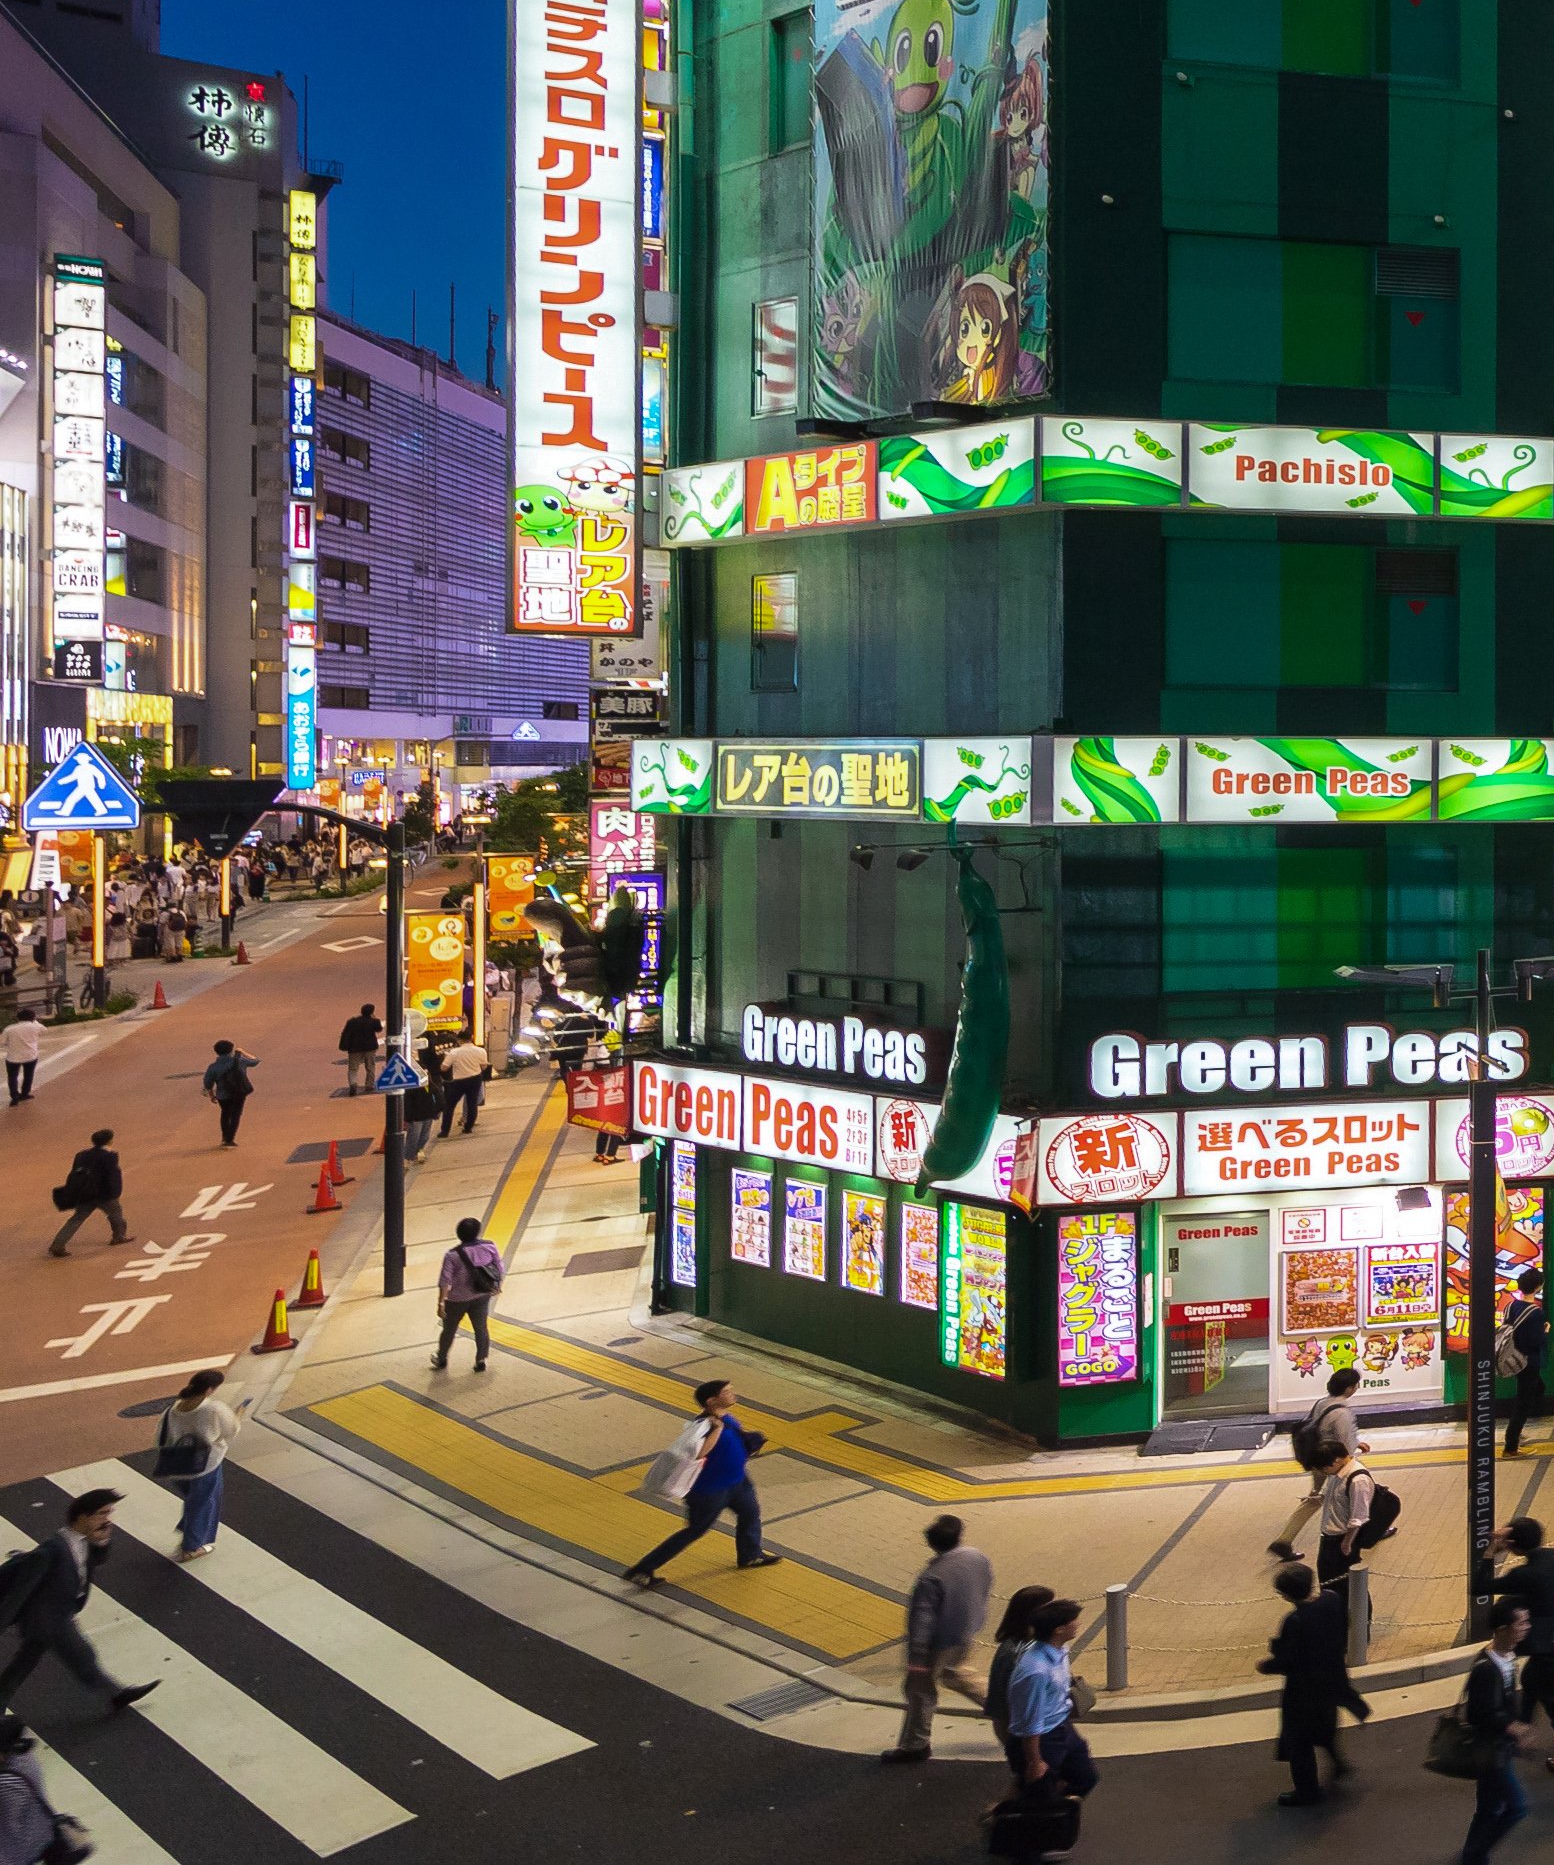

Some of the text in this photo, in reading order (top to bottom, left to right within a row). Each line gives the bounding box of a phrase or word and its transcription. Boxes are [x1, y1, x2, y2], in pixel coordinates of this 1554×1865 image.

[794, 446, 866, 490] タイプ
[1234, 454, 1392, 487] Pachislo
[753, 457, 799, 532] A
[799, 481, 867, 526] の殿堂
[58, 573, 99, 587] CRAB
[520, 546, 574, 626] 聖地
[579, 518, 632, 631] レア台の
[724, 751, 910, 809] レア台の聖地
[1211, 767, 1411, 798] Green Peas
[742, 1003, 927, 1085] Green Peas
[1090, 1024, 1526, 1099] Green Peas
[637, 1065, 840, 1161] Green Peas
[890, 1109, 917, 1153] 新
[1197, 1112, 1420, 1153] 選べるスロット
[1073, 1121, 1139, 1175] 新
[1218, 1147, 1401, 1183] Green Peas
[1069, 1167, 1163, 1200] スロット
[1080, 1213, 1118, 1236] 1F
[1178, 1224, 1259, 1242] Green Peas
[945, 1257, 961, 1316] Green
[1063, 1238, 1100, 1360] ジャグラー
[1100, 1235, 1136, 1342] まるごと
[1184, 1301, 1253, 1318] Green Peas
[1064, 1361, 1117, 1376] GOGO
[1362, 1376, 1391, 1389] Peas
[1476, 1359, 1491, 1451] SHINJUKU
